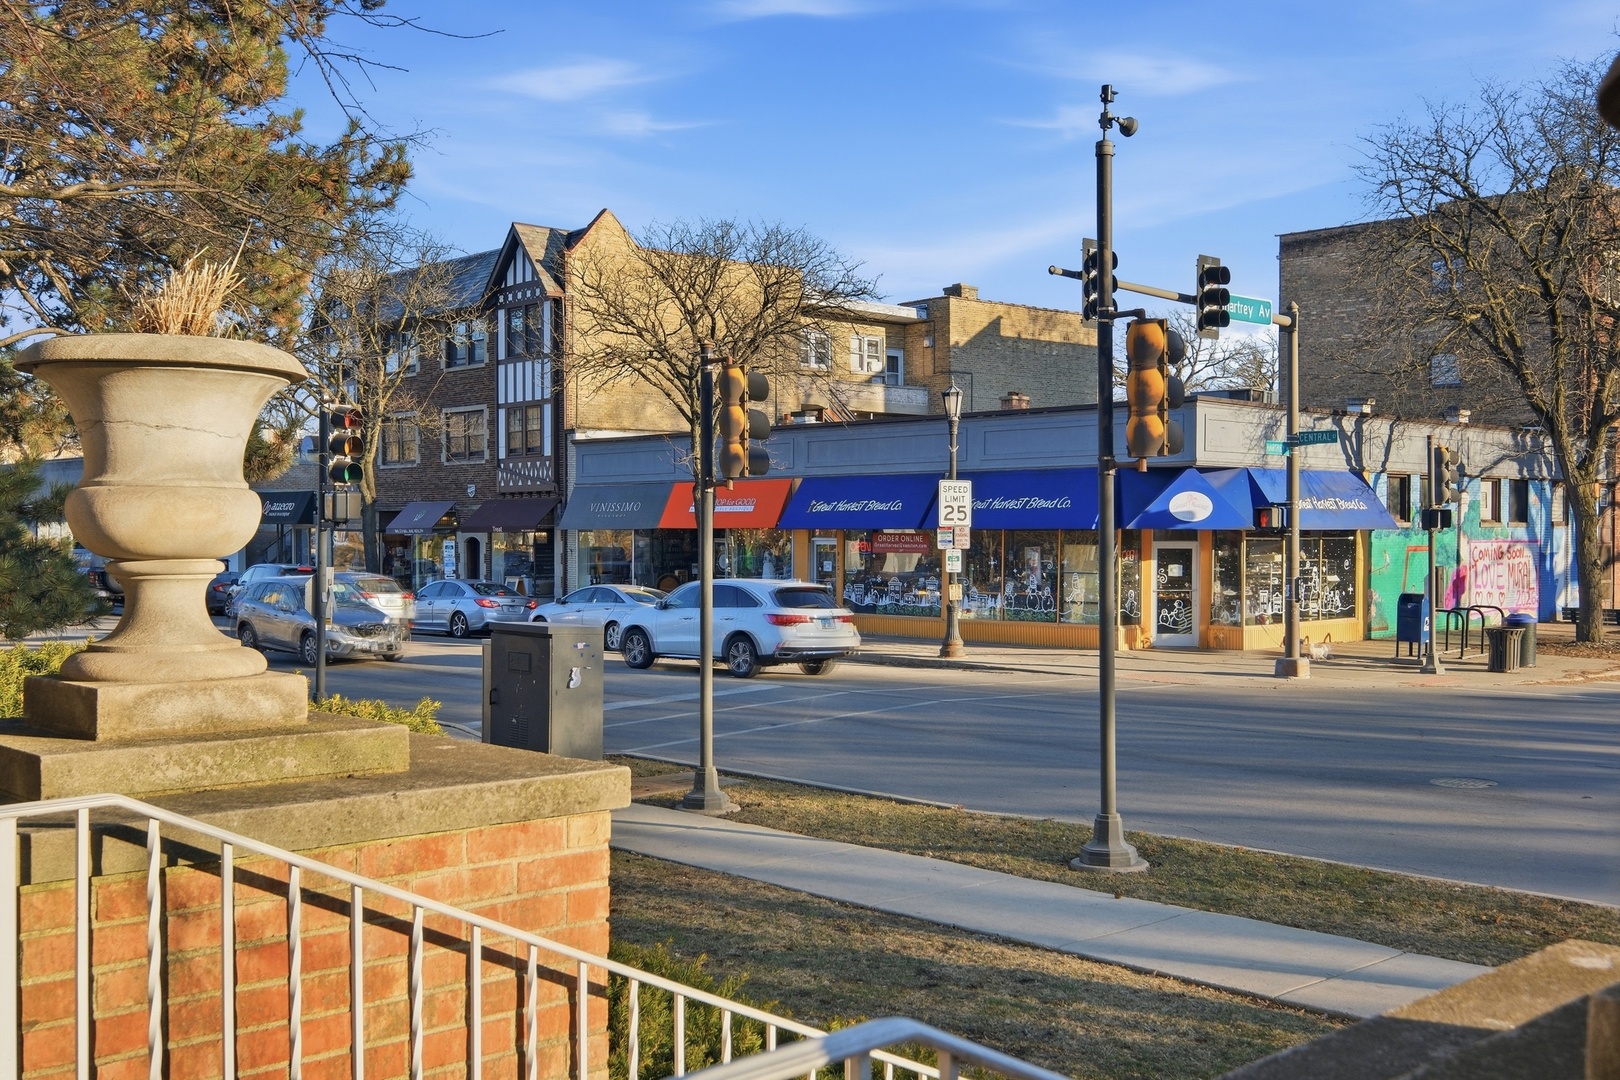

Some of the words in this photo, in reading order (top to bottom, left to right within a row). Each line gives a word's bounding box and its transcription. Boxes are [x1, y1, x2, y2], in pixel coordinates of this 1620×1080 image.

[1258, 305, 1271, 317] Av
[1299, 432, 1332, 442] CENTRAL
[943, 485, 969, 494] SPEED
[735, 497, 757, 506] GOOD
[945, 495, 966, 503] LIMIT
[970, 498, 993, 510] reat
[990, 496, 1030, 510] Harvest
[1026, 497, 1058, 510] Bread
[1056, 496, 1072, 508] Co.
[1311, 495, 1338, 510] Harvest
[590, 501, 642, 512] VINISSIMO
[813, 501, 837, 512] Great
[834, 499, 867, 512] Harvest
[864, 500, 892, 511] Bread
[943, 505, 967, 522] 25
[877, 534, 899, 543] ORDER
[900, 534, 924, 543] ONLINE
[850, 541, 872, 552] OPEN
[1474, 562, 1505, 590] LOVE
[1507, 561, 1535, 591] MURAL
[1515, 589, 1539, 606] 2026
